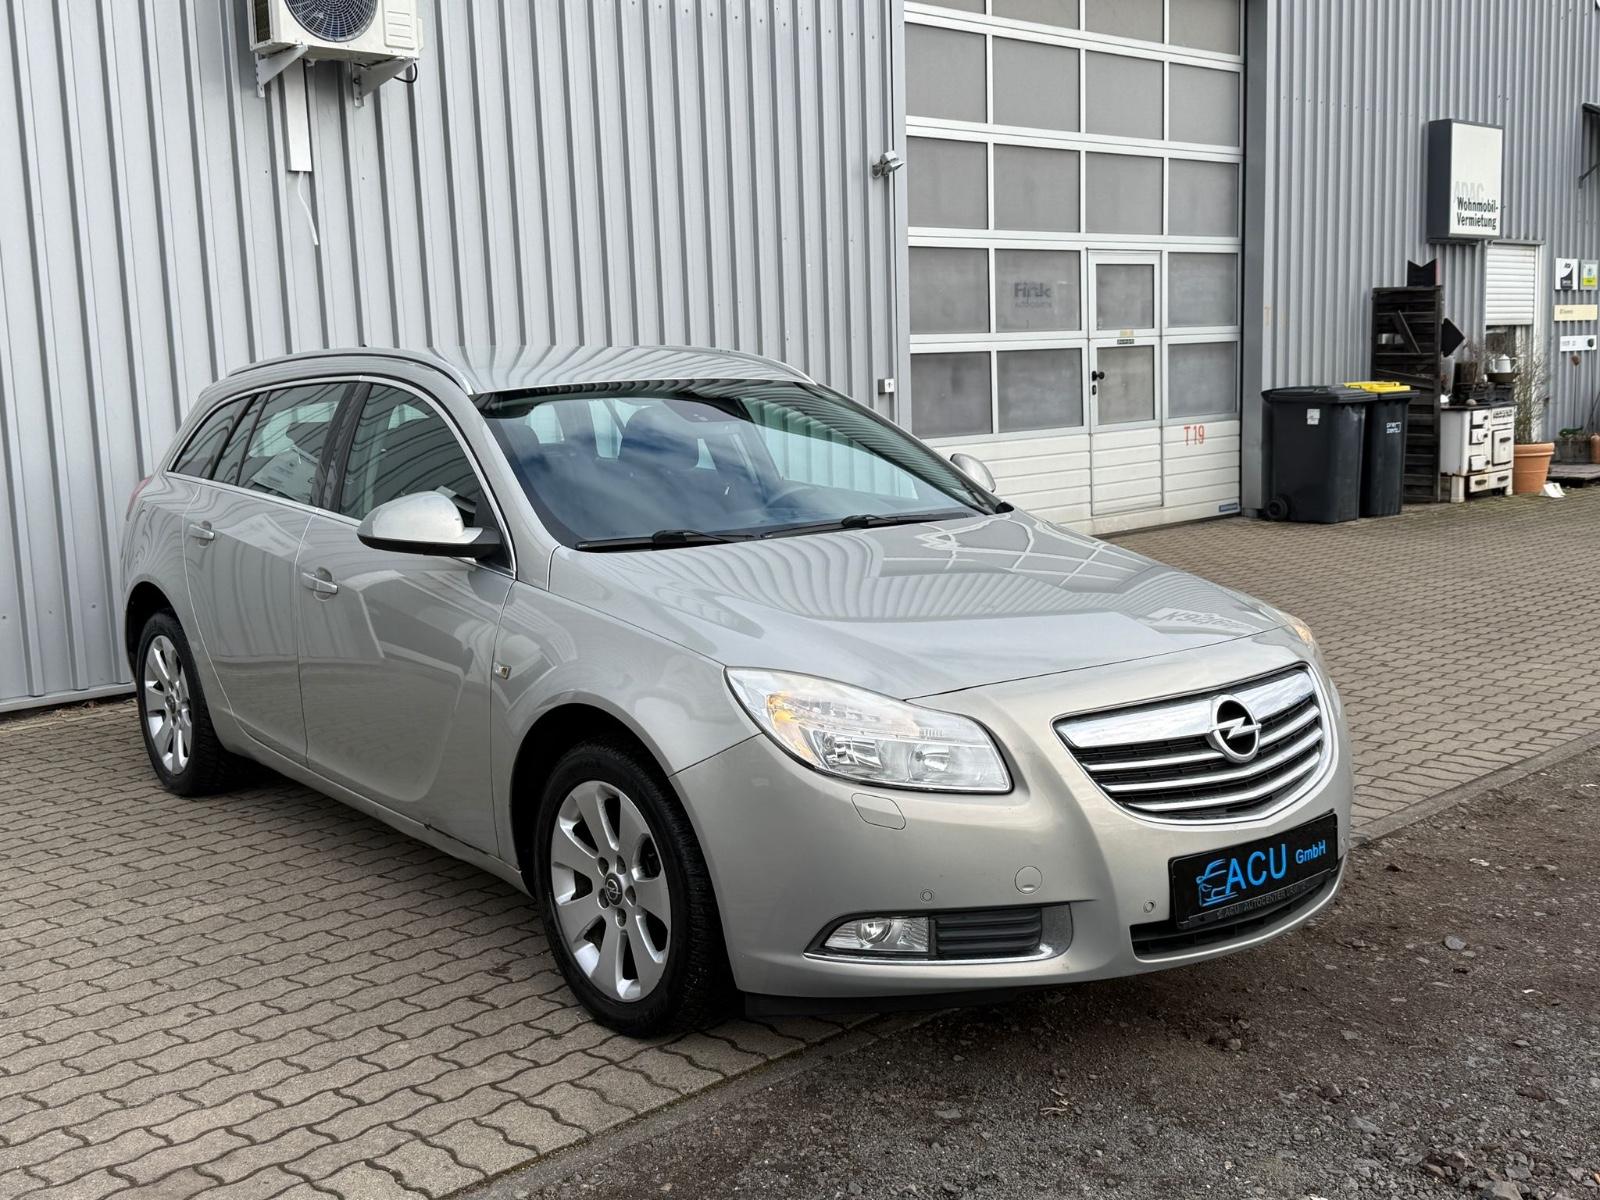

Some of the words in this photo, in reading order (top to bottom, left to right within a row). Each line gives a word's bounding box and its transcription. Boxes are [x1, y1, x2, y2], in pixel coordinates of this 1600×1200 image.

[1457, 197, 1499, 213] Wohnmobil-
[1457, 212, 1497, 230] Vermietung
[1225, 843, 1287, 895] ACU
[1295, 840, 1326, 864] GmbH
